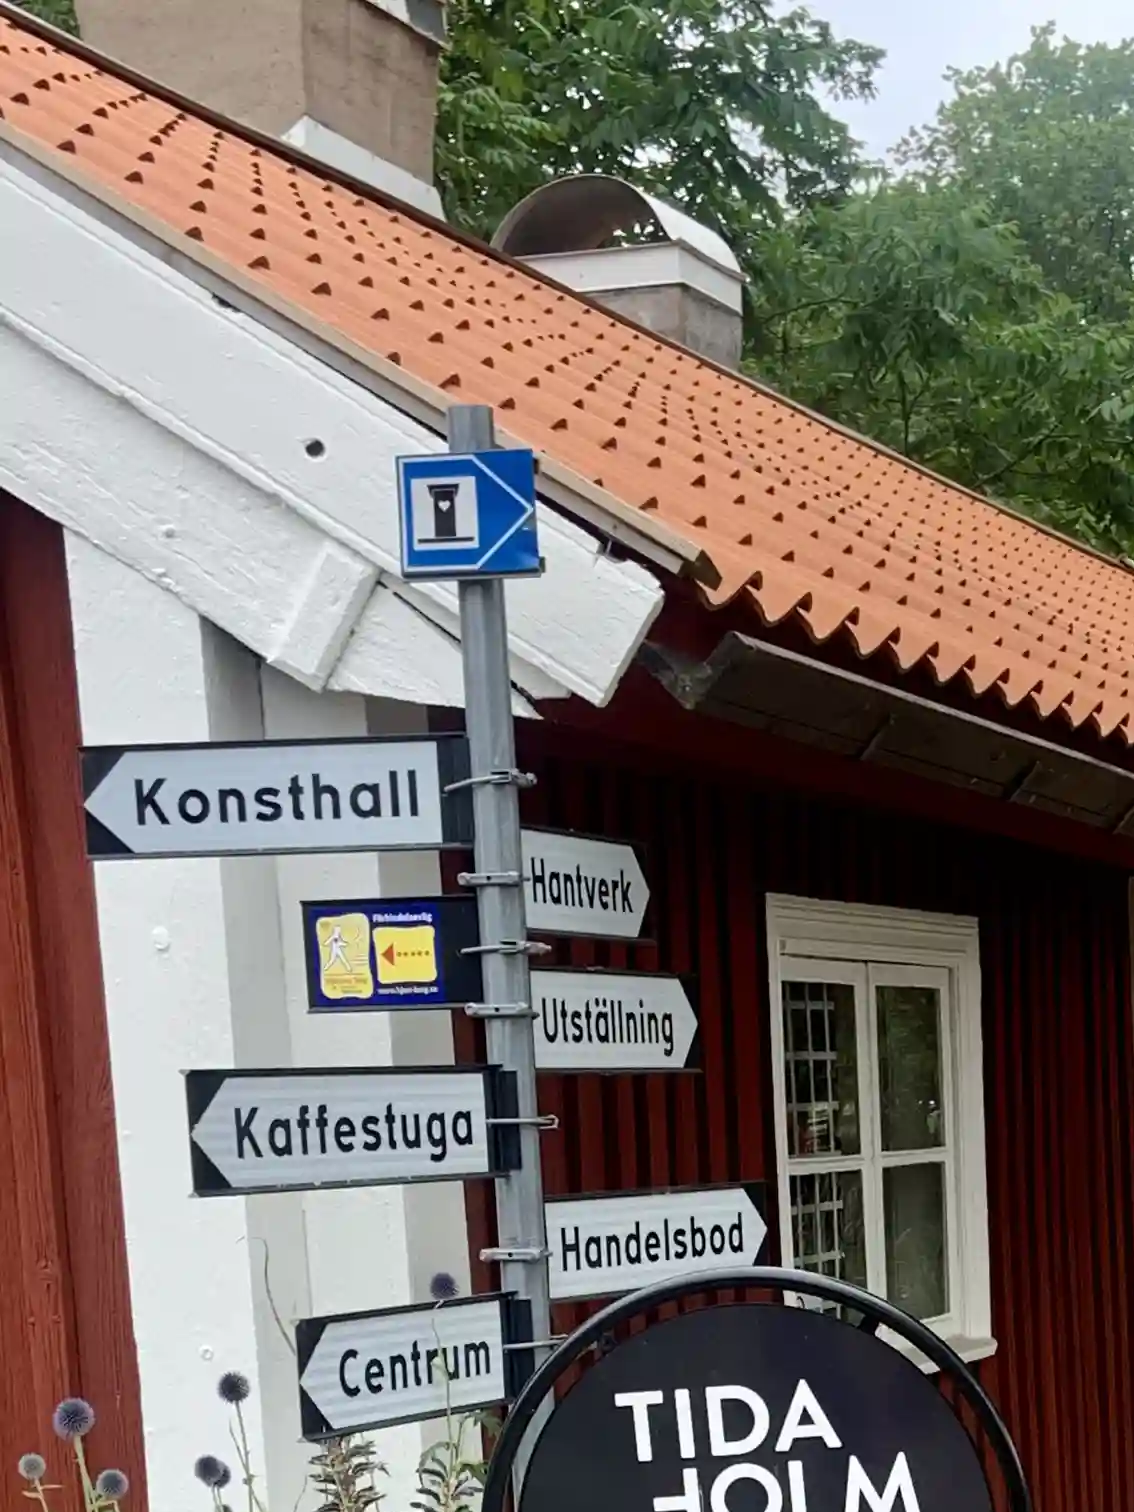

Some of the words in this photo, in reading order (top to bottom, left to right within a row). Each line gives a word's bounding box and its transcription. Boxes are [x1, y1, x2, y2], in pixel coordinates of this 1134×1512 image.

[134, 770, 420, 826] Konsthall
[530, 857, 635, 914] Hantverk
[543, 996, 675, 1058] Utställning
[234, 1102, 474, 1162] Kaffestuga
[560, 1211, 744, 1272] Handelsbod
[339, 1338, 492, 1397] Centrum
[614, 1378, 843, 1463] TIDA
